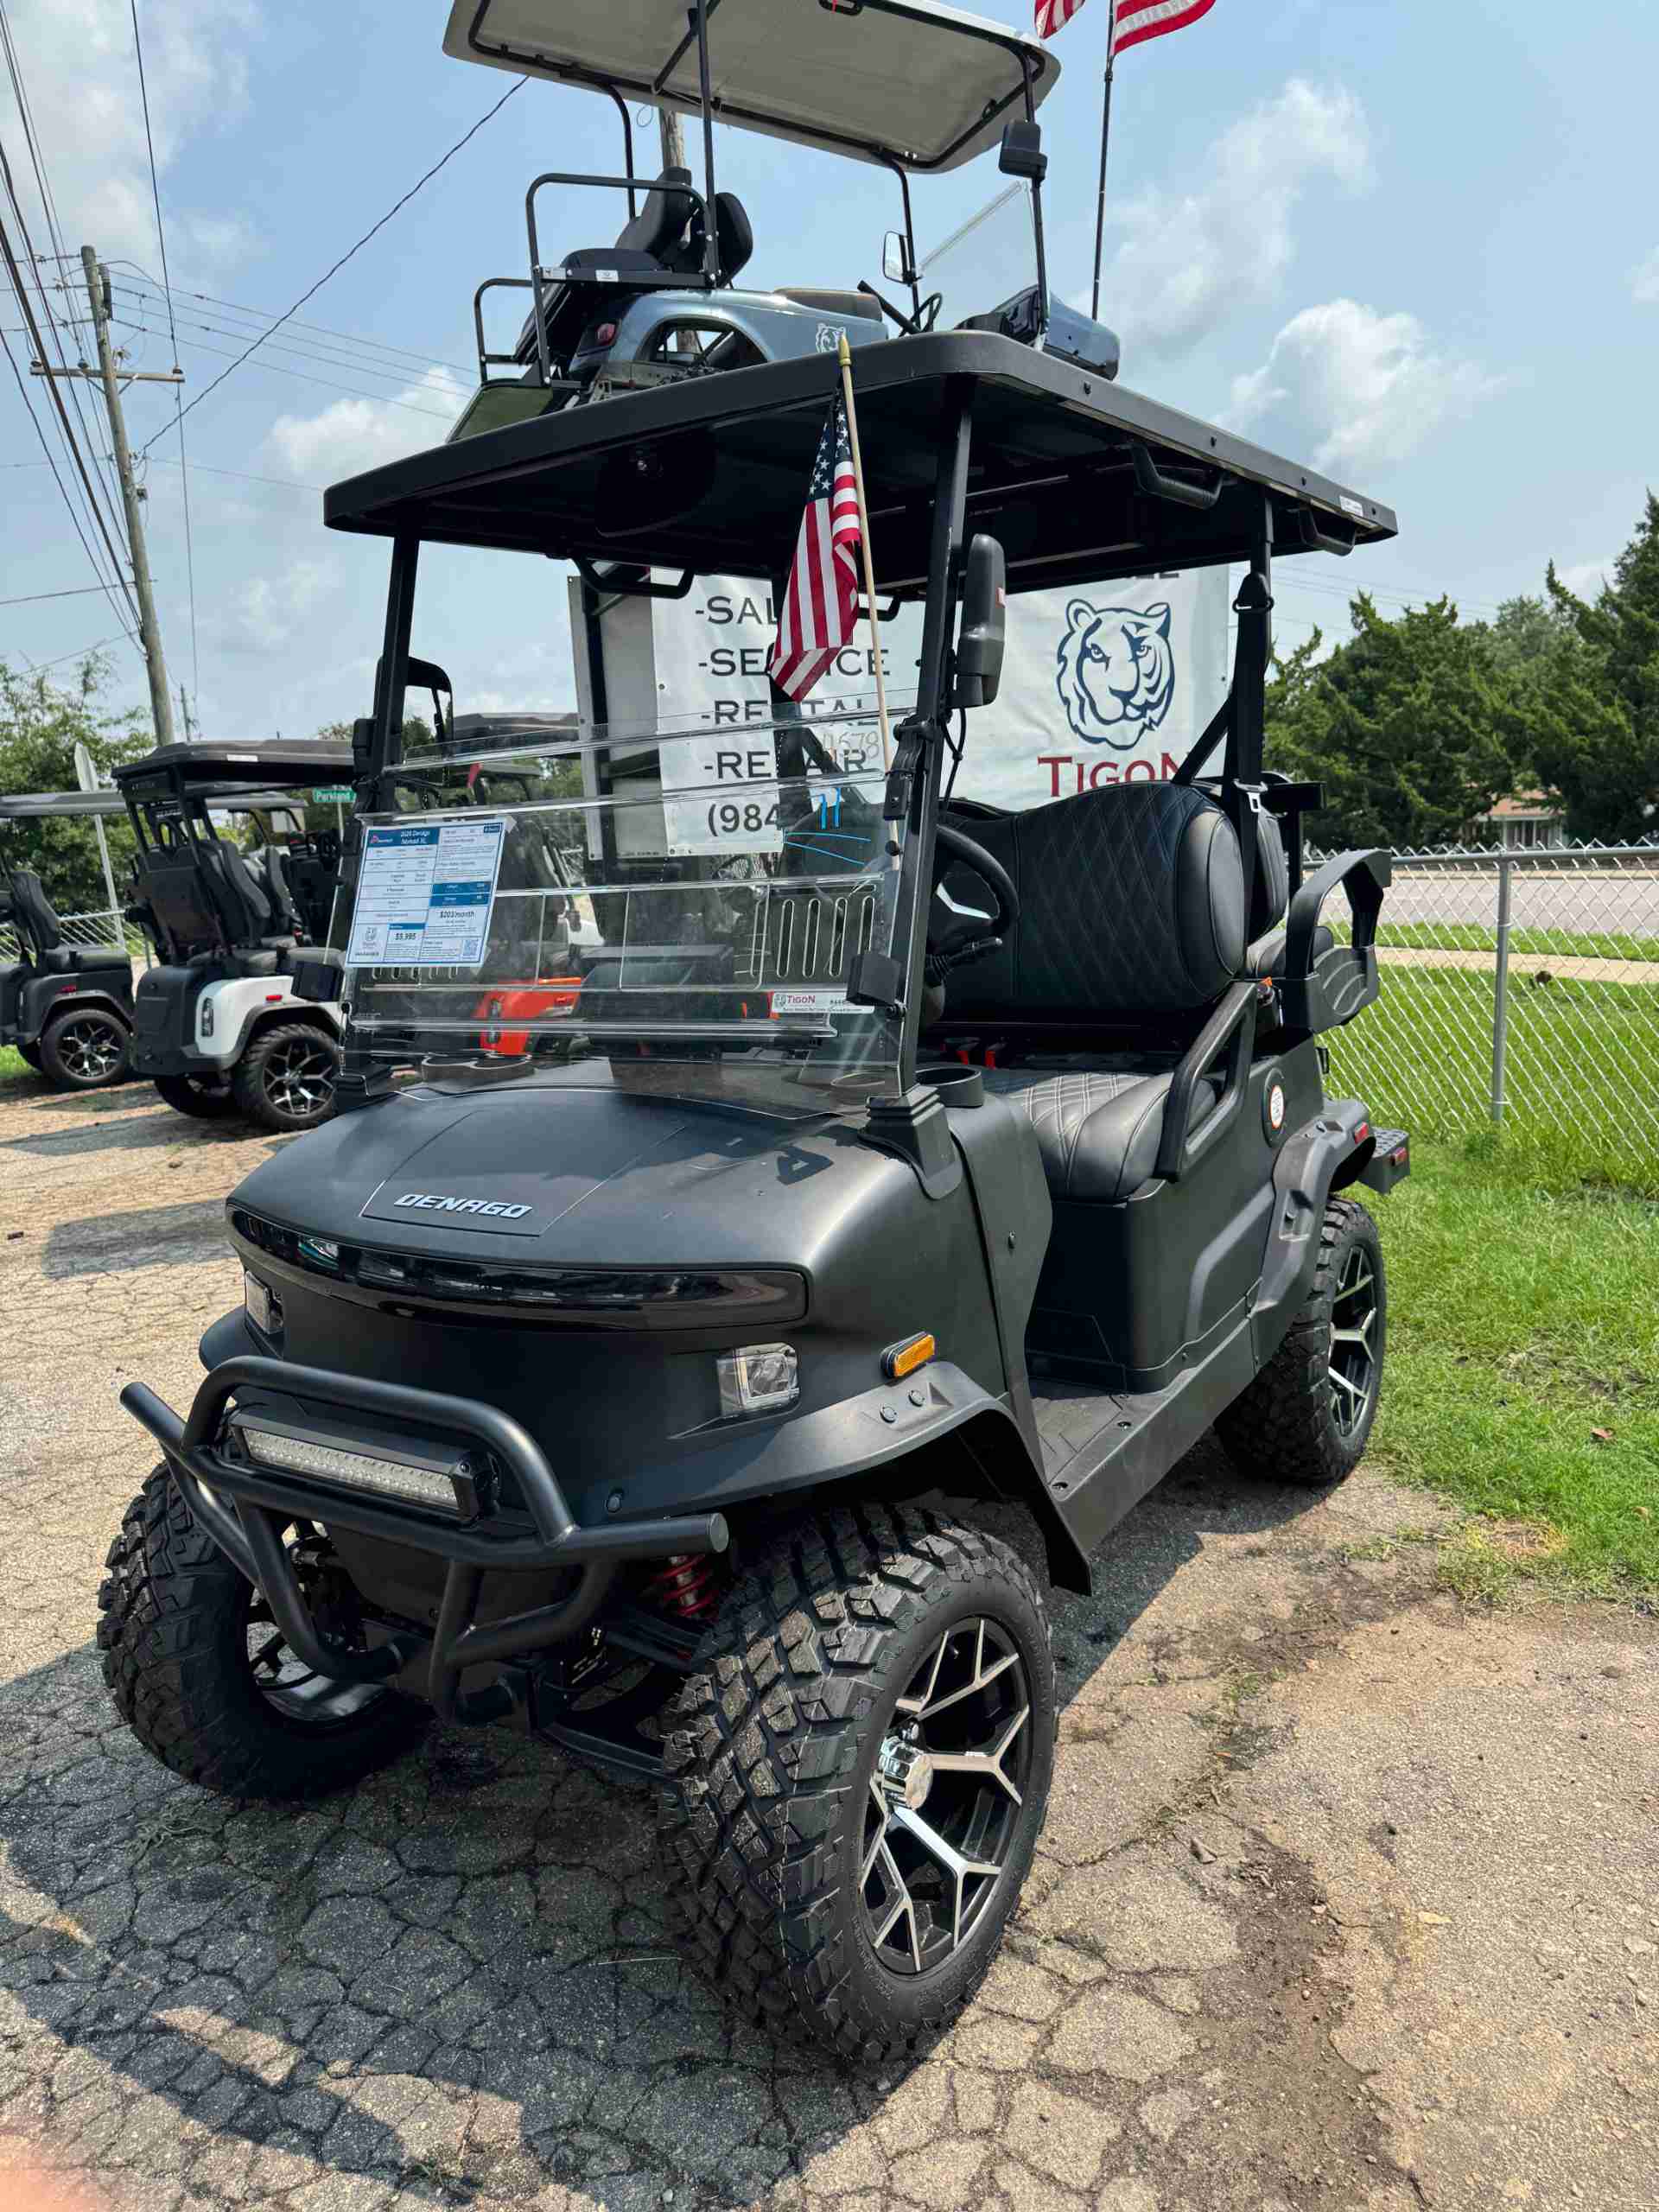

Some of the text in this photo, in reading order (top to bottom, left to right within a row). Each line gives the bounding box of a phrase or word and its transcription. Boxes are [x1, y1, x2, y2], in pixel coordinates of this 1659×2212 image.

[698, 648, 890, 677] -SECE
[701, 699, 880, 725] -RETAL
[394, 1193, 533, 1219] DENAGO
